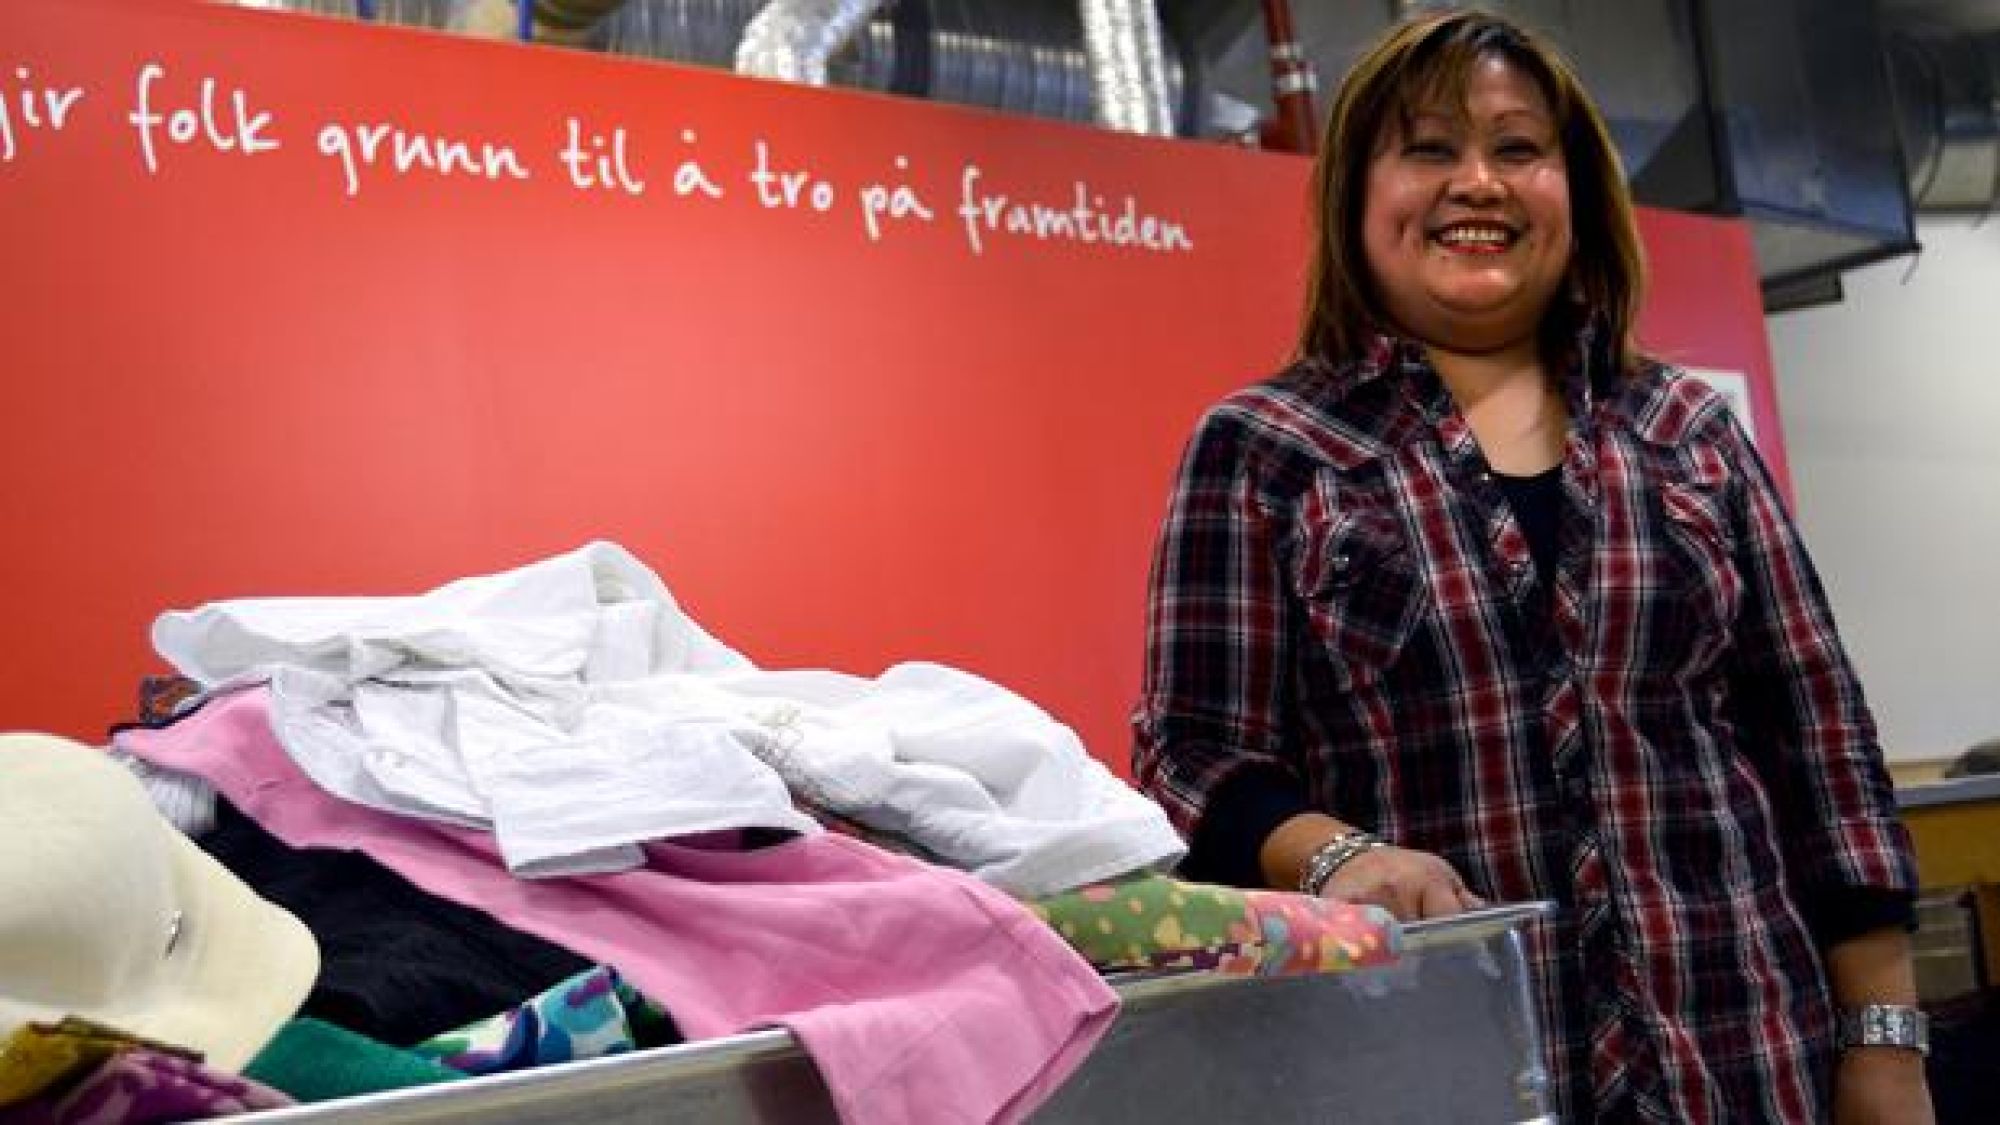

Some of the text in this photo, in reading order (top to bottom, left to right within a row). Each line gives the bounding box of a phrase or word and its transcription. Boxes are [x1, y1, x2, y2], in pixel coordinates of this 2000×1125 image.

[0, 66, 85, 161] ir
[129, 63, 281, 173] folk
[560, 118, 644, 196] til
[673, 128, 724, 200] å
[751, 140, 835, 213] tro
[861, 153, 935, 242] på
[957, 165, 1194, 255] framtiden
